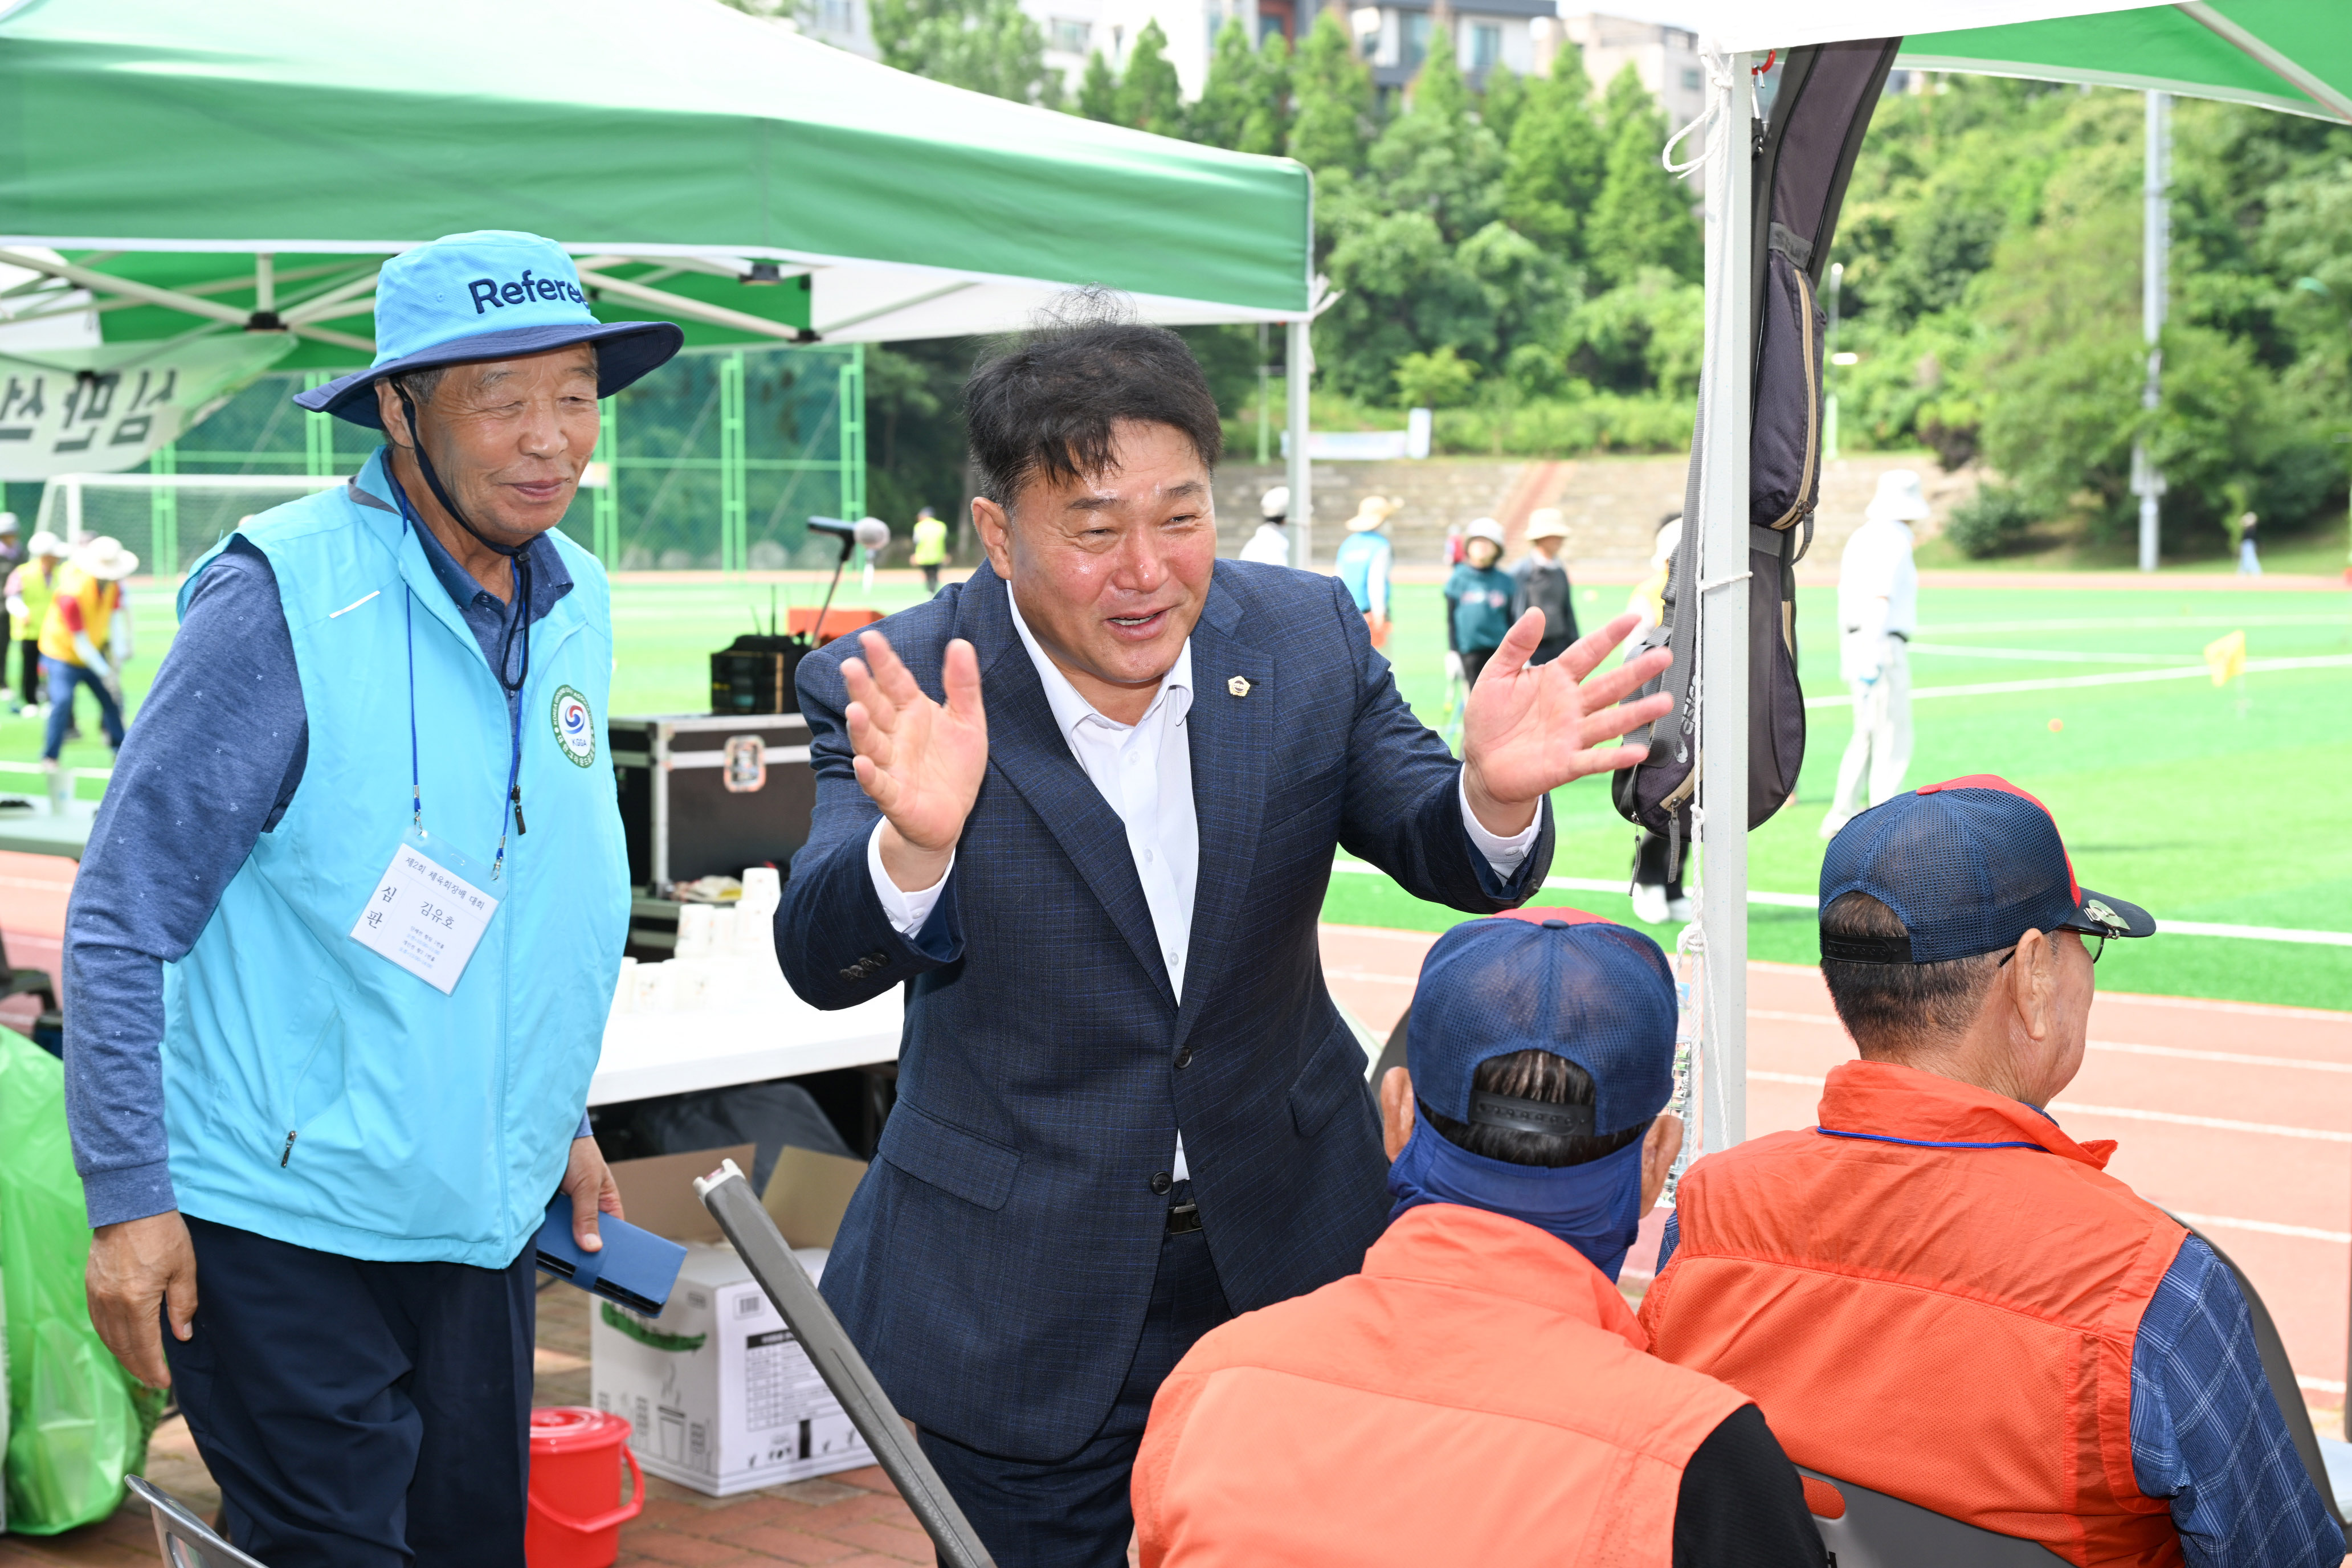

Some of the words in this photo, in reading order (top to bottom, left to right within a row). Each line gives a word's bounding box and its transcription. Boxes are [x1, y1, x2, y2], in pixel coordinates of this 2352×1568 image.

[405, 856, 426, 875] 제2회
[428, 871, 467, 899] 체육회장배
[469, 894, 485, 910] 대회
[420, 901, 455, 929] 김유호
